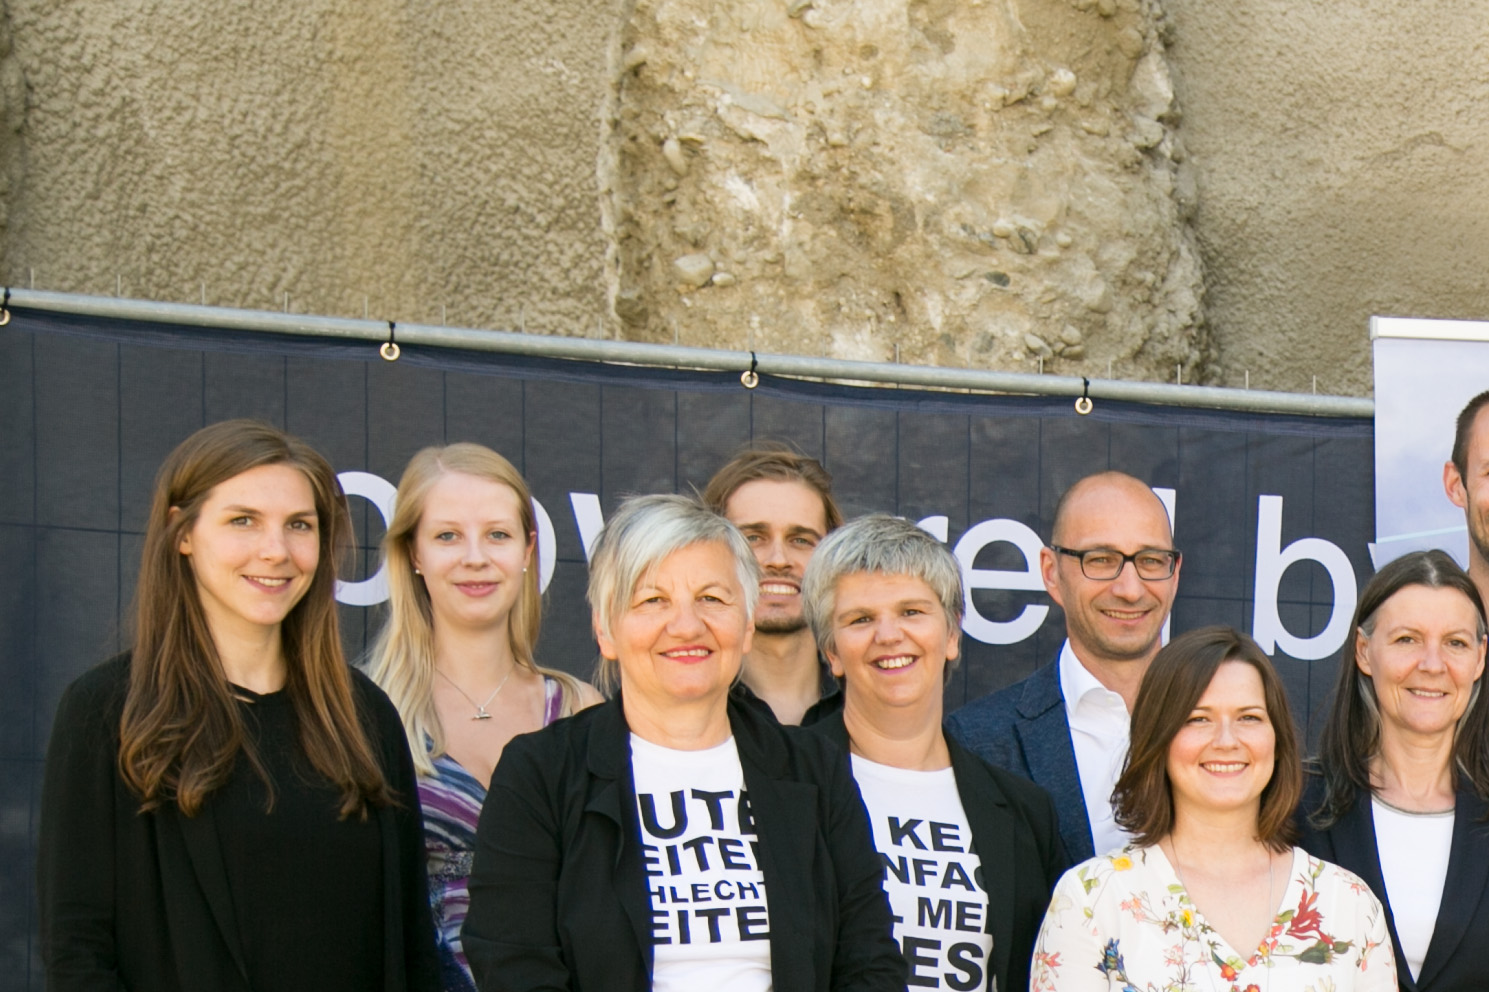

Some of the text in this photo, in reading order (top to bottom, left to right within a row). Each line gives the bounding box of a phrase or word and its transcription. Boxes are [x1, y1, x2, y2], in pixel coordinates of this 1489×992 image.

[1252, 495, 1376, 660] b
[887, 816, 973, 854] KE
[651, 880, 765, 903] HLECH
[917, 896, 989, 933] ME
